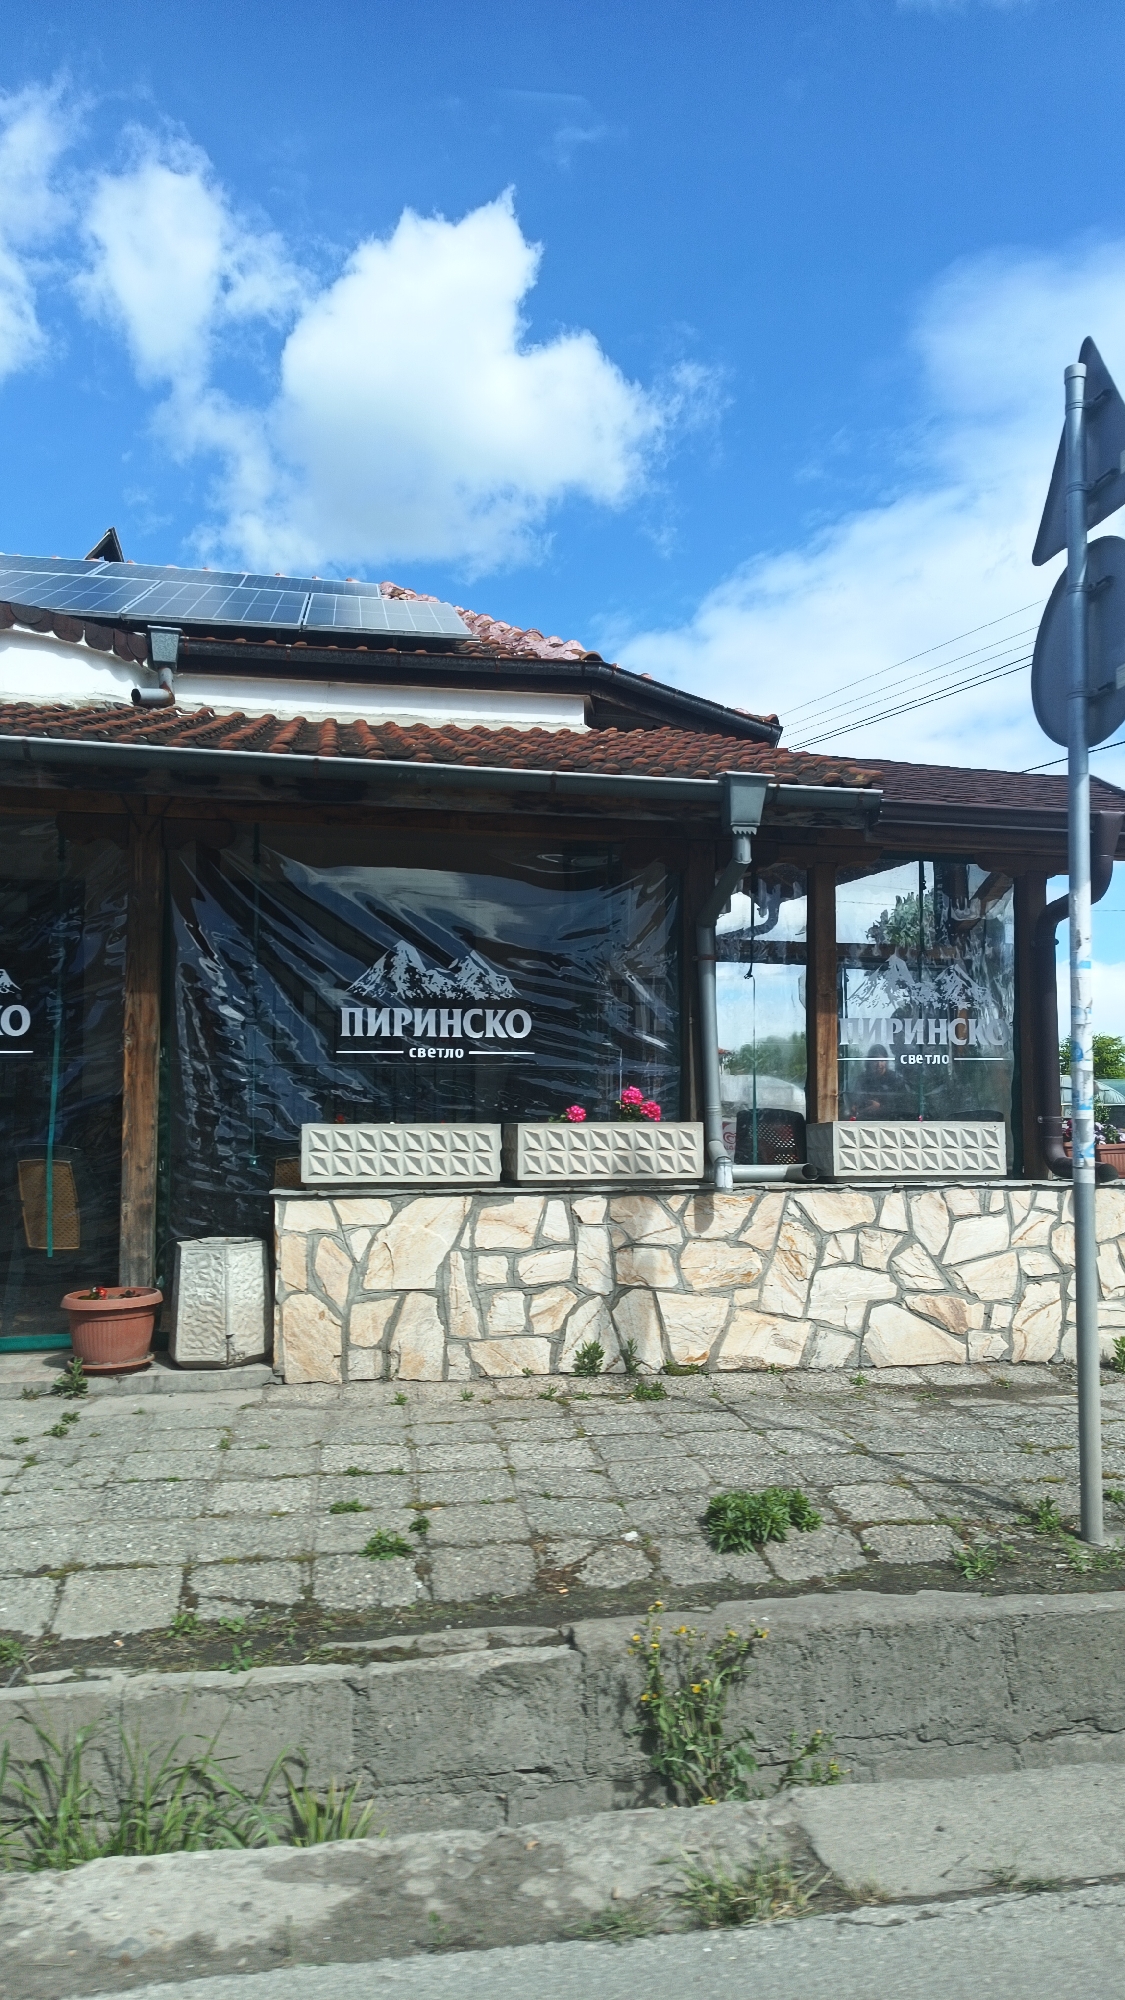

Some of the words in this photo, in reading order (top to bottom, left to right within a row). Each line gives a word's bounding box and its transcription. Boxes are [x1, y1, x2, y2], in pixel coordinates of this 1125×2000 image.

[340, 1007, 532, 1039] ПИРИНСКО
[839, 1017, 1010, 1046] ПИРИНСКО
[409, 1047, 464, 1059] светло
[900, 1053, 950, 1065] светло
